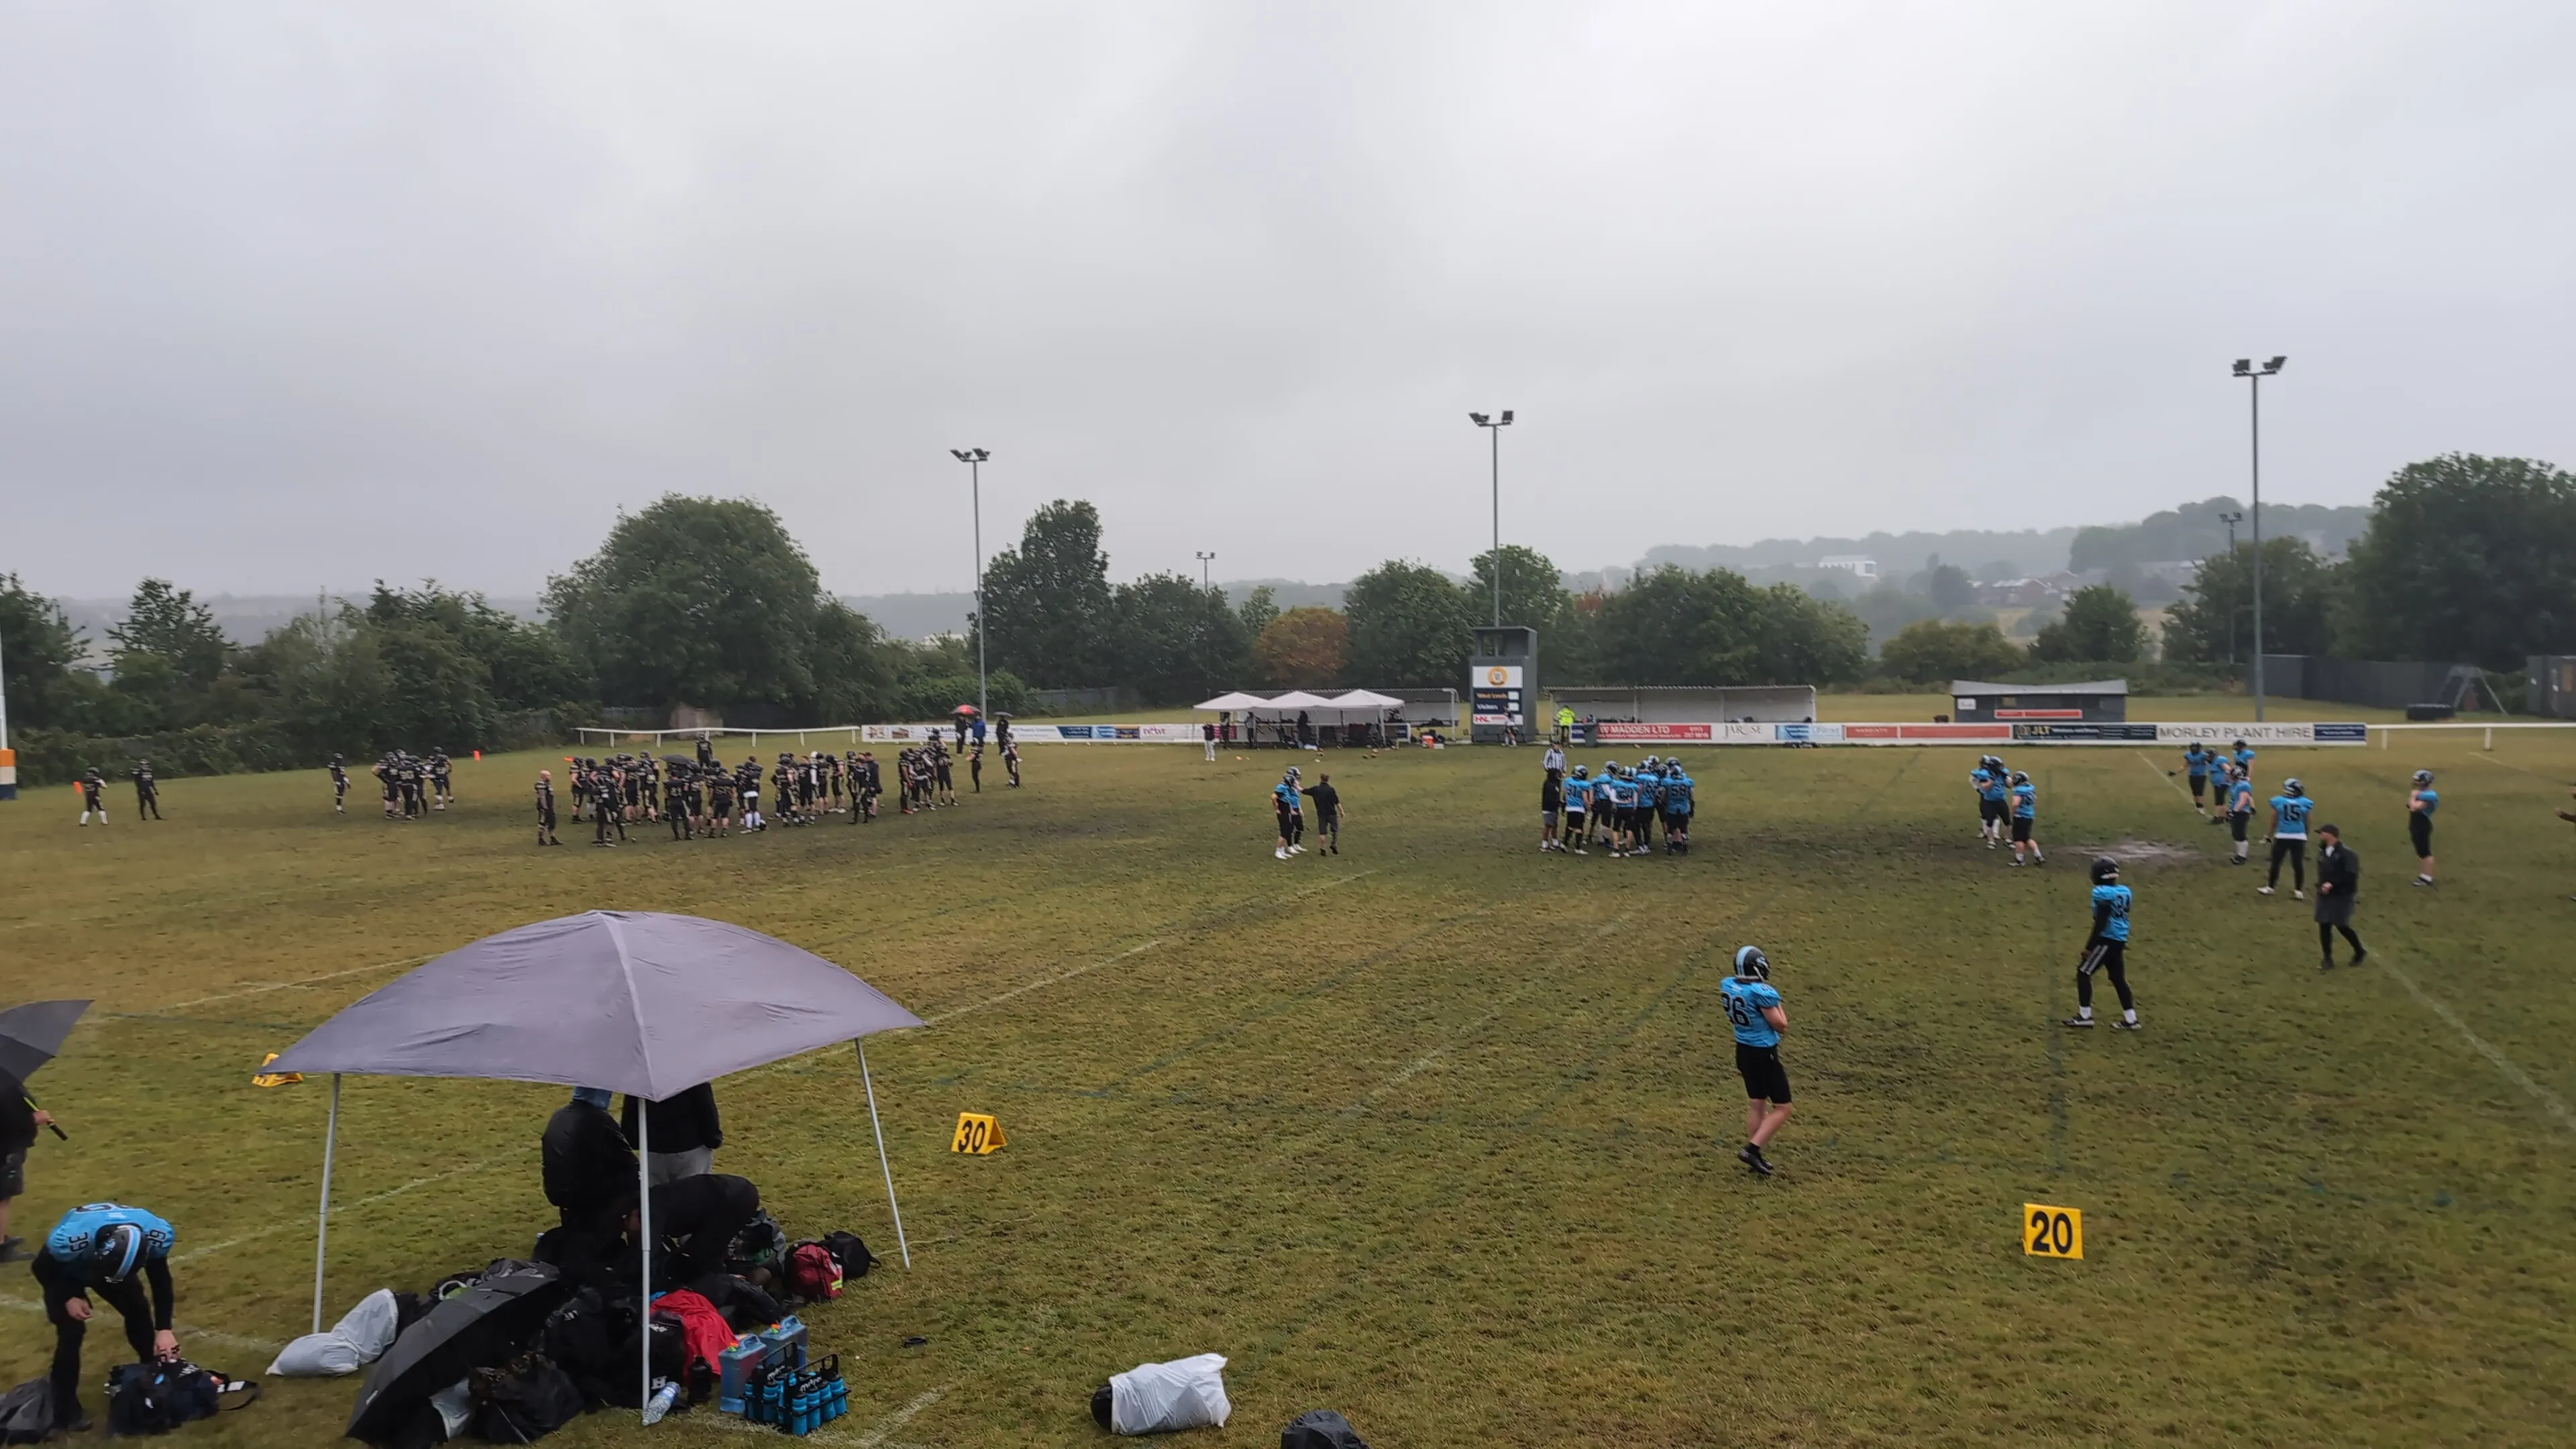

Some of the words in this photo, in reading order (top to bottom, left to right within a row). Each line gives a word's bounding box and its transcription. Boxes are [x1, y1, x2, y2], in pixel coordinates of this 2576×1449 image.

[2158, 726, 2219, 739] MORLEY
[2224, 727, 2273, 739] PLANT
[2275, 727, 2313, 739] HIRE
[2284, 804, 2301, 822] 15
[957, 1120, 985, 1152] 30
[68, 1232, 89, 1252] 39
[2031, 1211, 2072, 1254] 20
